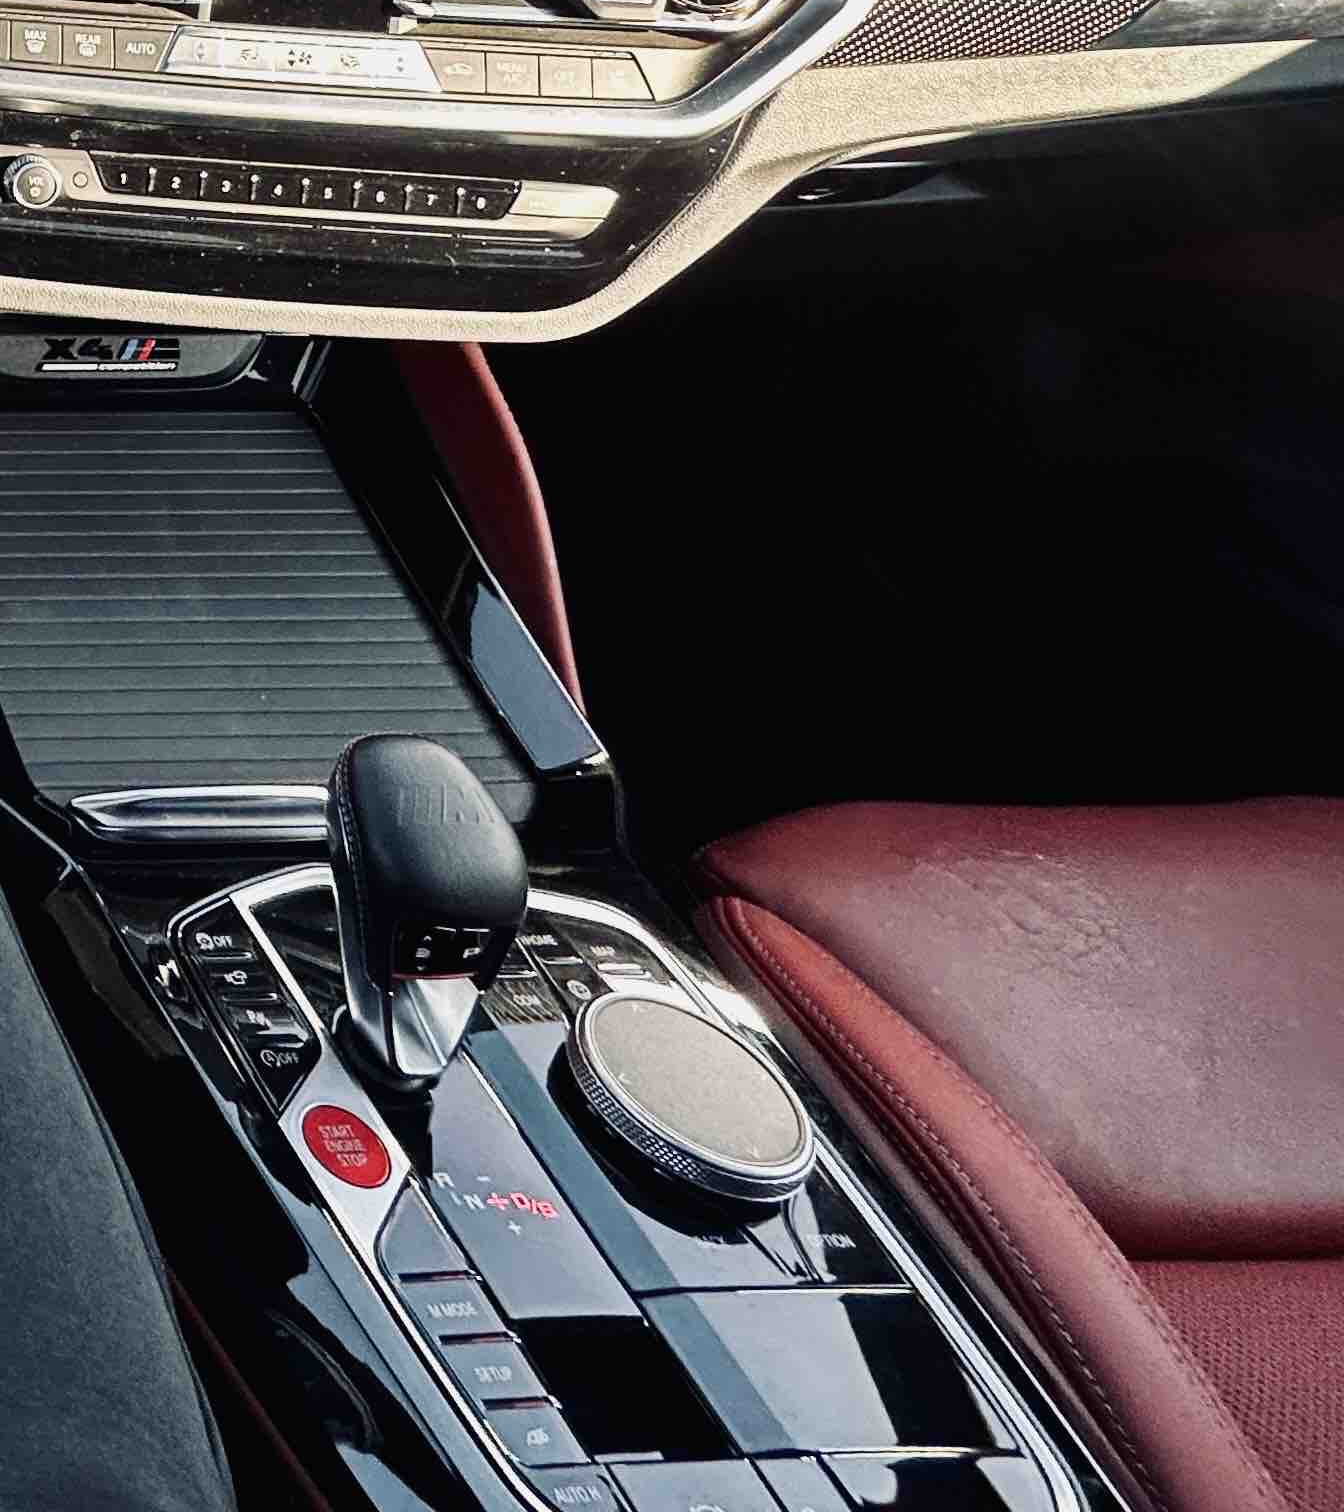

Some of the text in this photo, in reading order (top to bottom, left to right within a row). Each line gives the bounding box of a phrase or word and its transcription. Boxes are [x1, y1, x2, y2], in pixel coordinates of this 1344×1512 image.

[24, 29, 48, 41] MAX
[75, 33, 101, 45] REAR
[125, 41, 156, 55] AUTO
[120, 172, 129, 185] 1
[42, 338, 114, 361] X4
[212, 935, 233, 948] OFF
[279, 1052, 300, 1065] OFF
[318, 1124, 354, 1139] START
[324, 1138, 368, 1152] ENGINE
[336, 1152, 368, 1168] STOP
[473, 1366, 513, 1383] SETUP
[553, 1487, 585, 1504] AUTO
